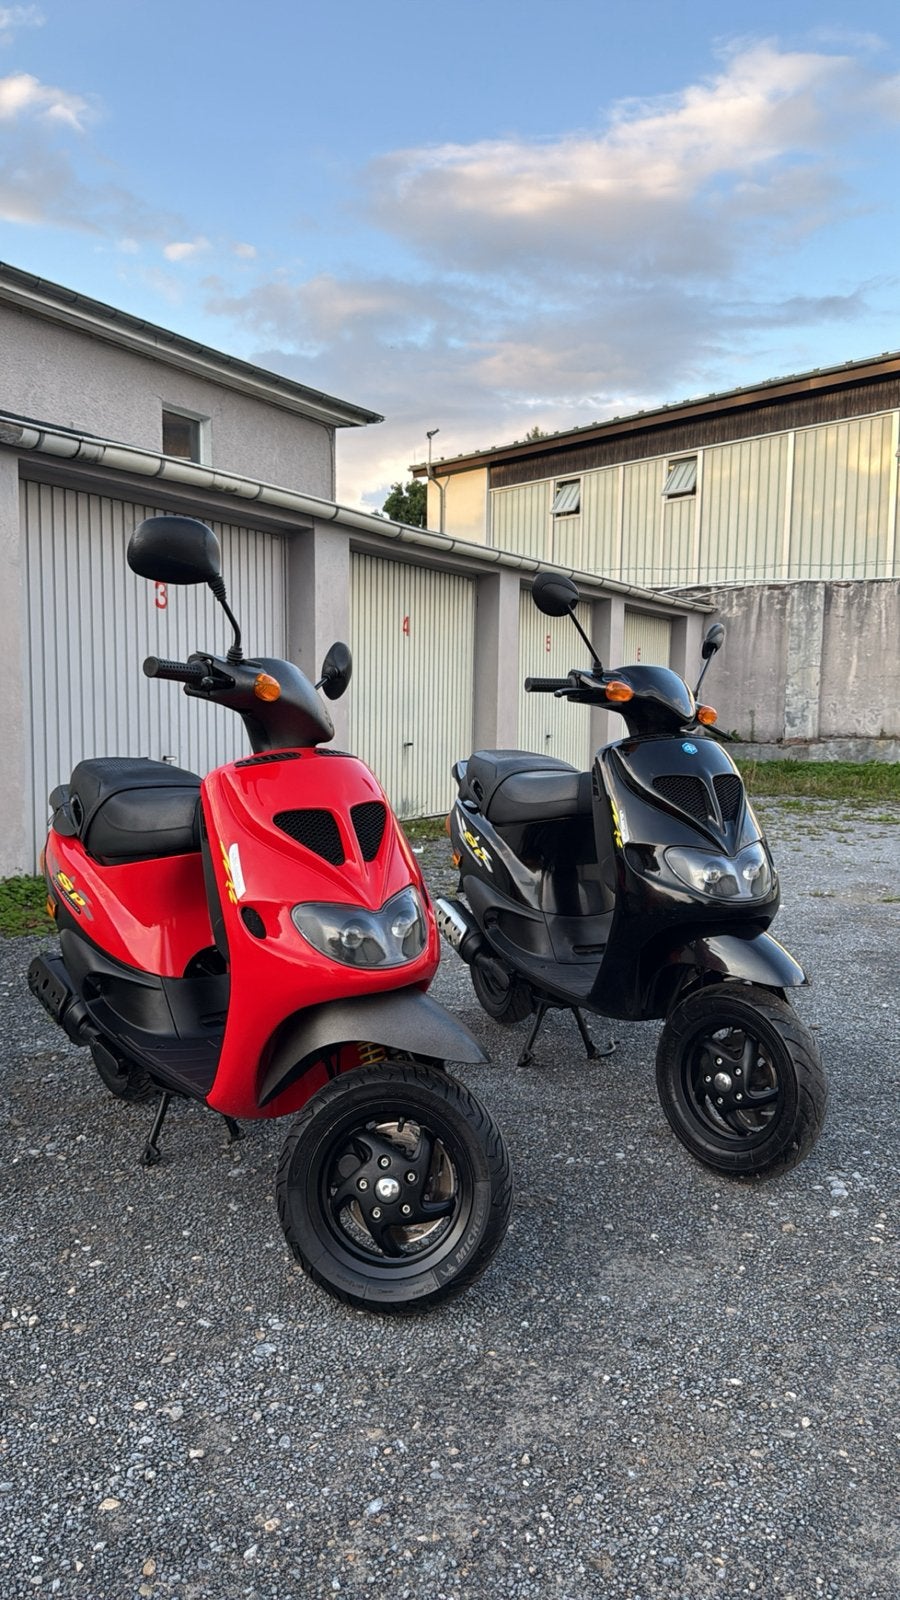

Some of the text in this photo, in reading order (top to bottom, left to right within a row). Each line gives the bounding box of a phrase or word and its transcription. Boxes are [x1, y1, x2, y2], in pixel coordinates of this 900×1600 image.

[154, 580, 168, 609] 3
[402, 615, 410, 637] 4
[455, 1195, 487, 1263] MICHEL
